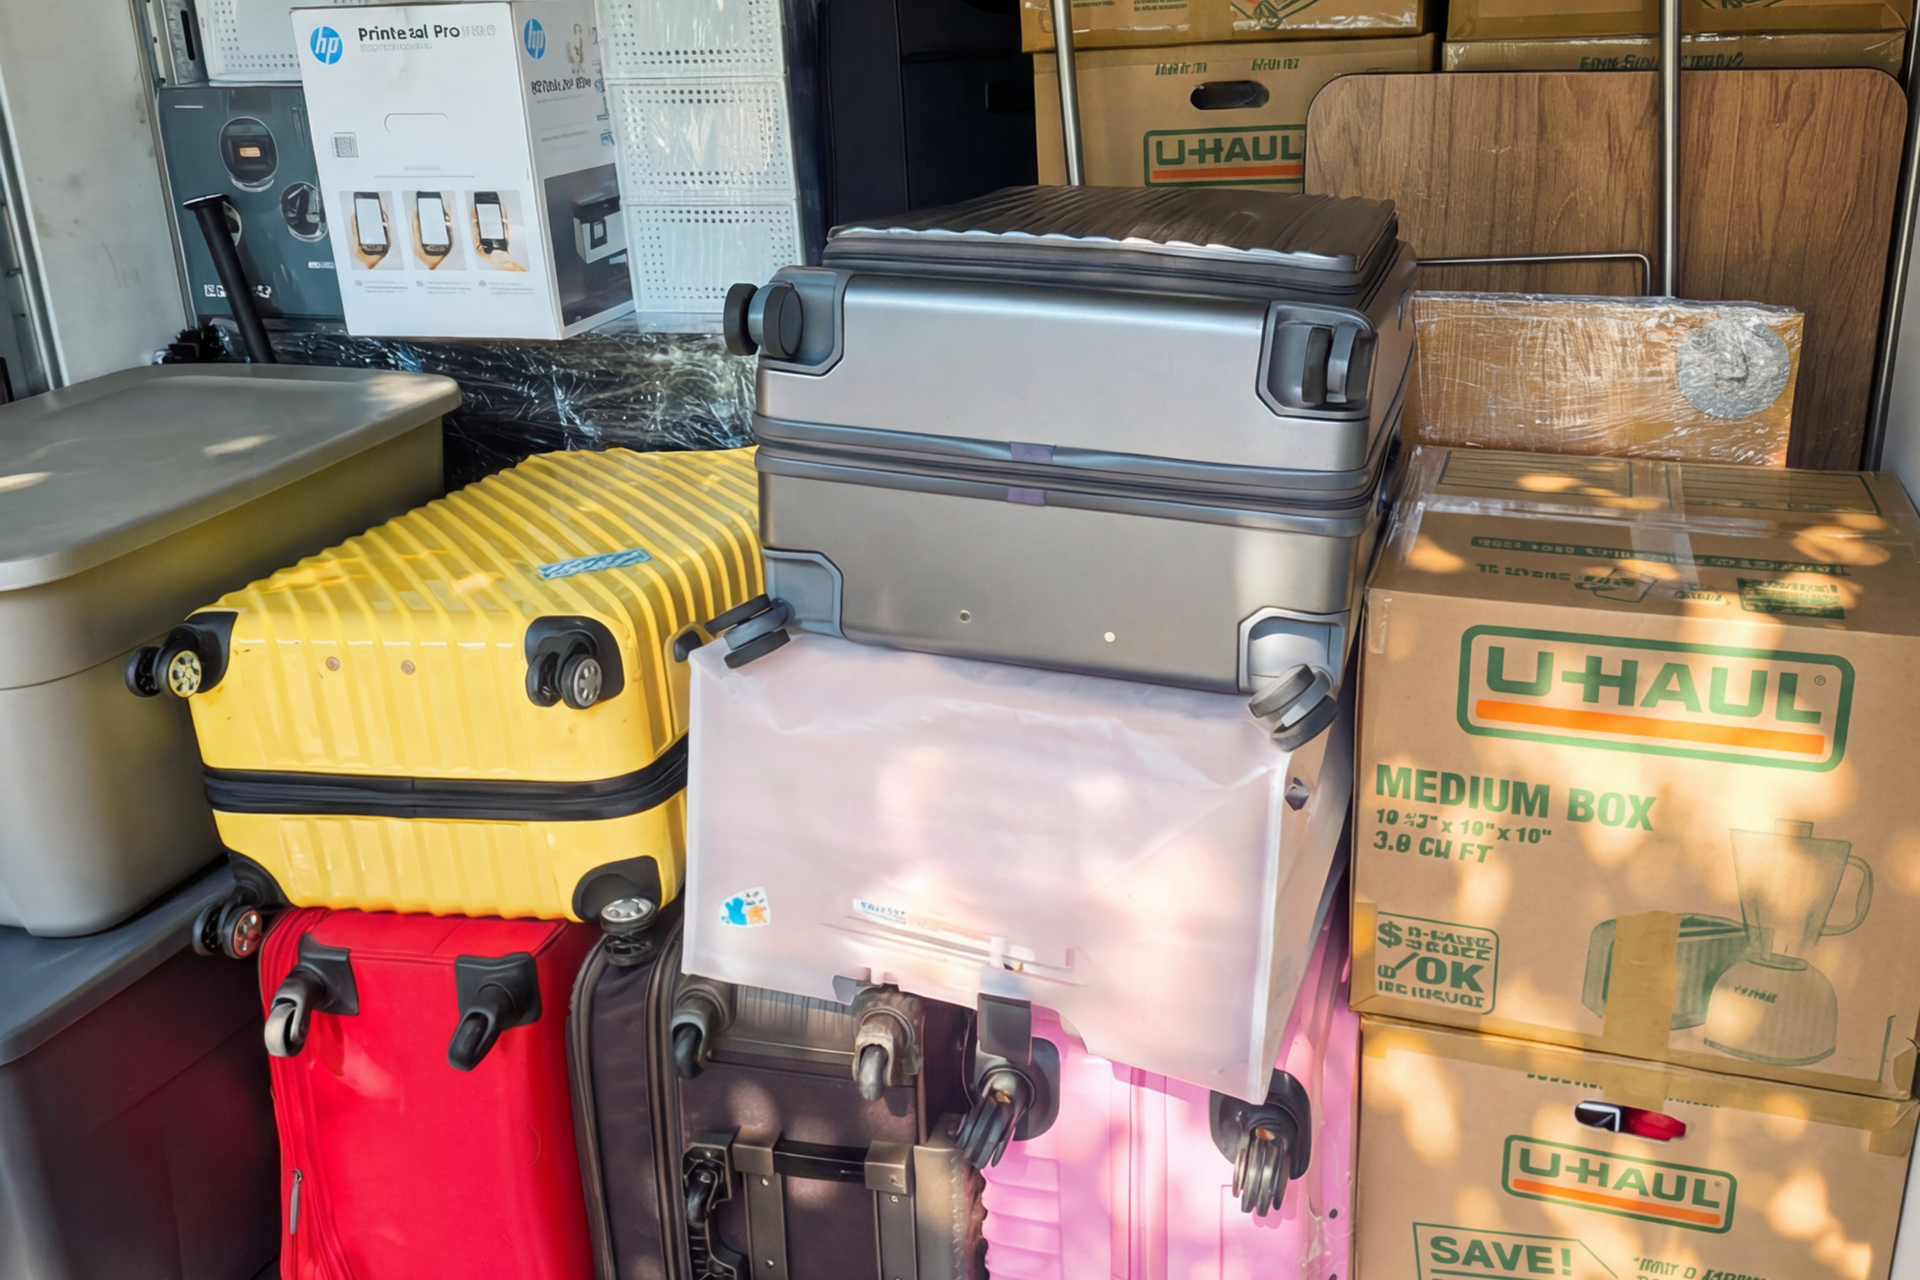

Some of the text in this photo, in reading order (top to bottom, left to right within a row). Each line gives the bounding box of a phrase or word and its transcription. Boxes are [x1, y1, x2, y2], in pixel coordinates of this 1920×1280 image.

[311, 26, 342, 65] hp
[434, 24, 461, 39] Pro
[524, 18, 546, 60] hp
[1155, 135, 1303, 166] U-HAUL
[1486, 645, 1822, 725] U-HAUL
[1375, 764, 1658, 832] MEDIUM BOX
[1458, 842, 1494, 864] FT
[1415, 956, 1485, 994] OK
[1519, 1147, 1721, 1210] U-HAUL
[1429, 1235, 1573, 1277] SAVE!
